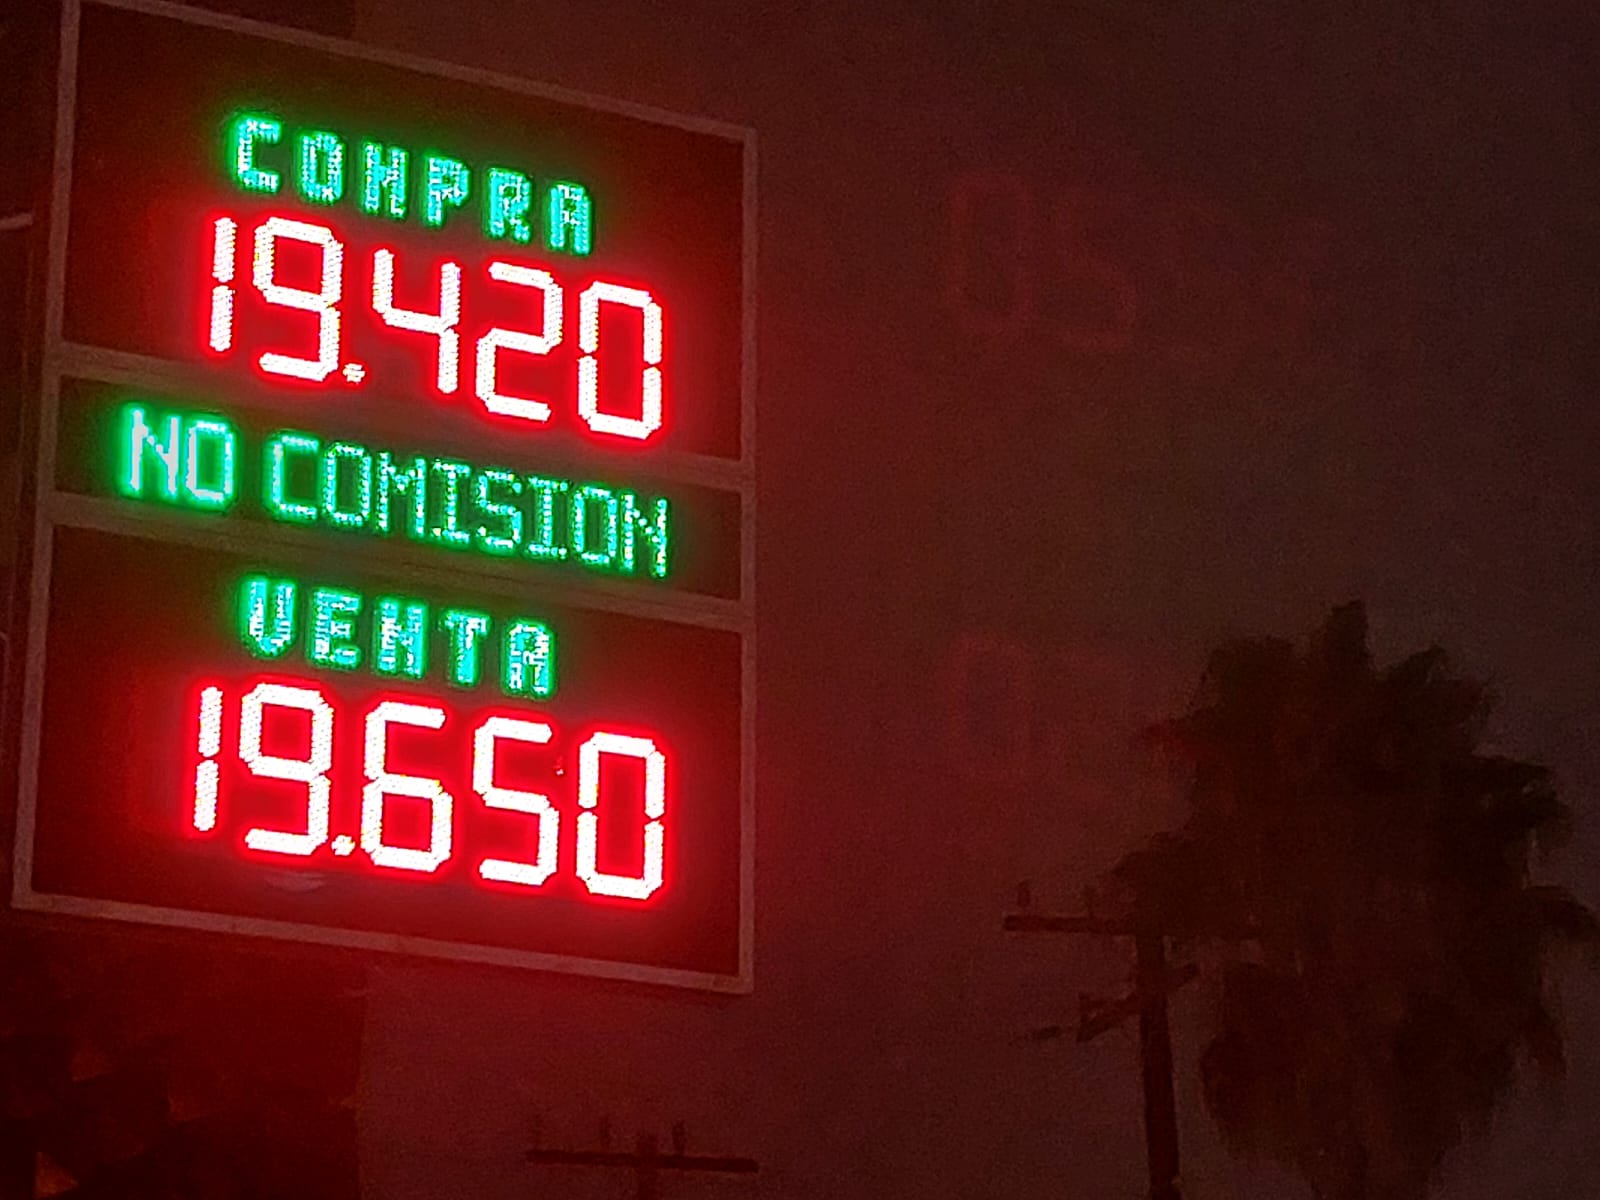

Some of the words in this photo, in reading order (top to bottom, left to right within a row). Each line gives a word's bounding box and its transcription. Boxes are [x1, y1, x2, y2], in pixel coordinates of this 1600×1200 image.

[234, 114, 592, 255] COMPRA
[210, 217, 664, 440] 19.420
[120, 405, 238, 507] NO
[266, 432, 670, 579] COMISION
[242, 578, 556, 696] VENTA
[193, 684, 667, 900] 19.650
